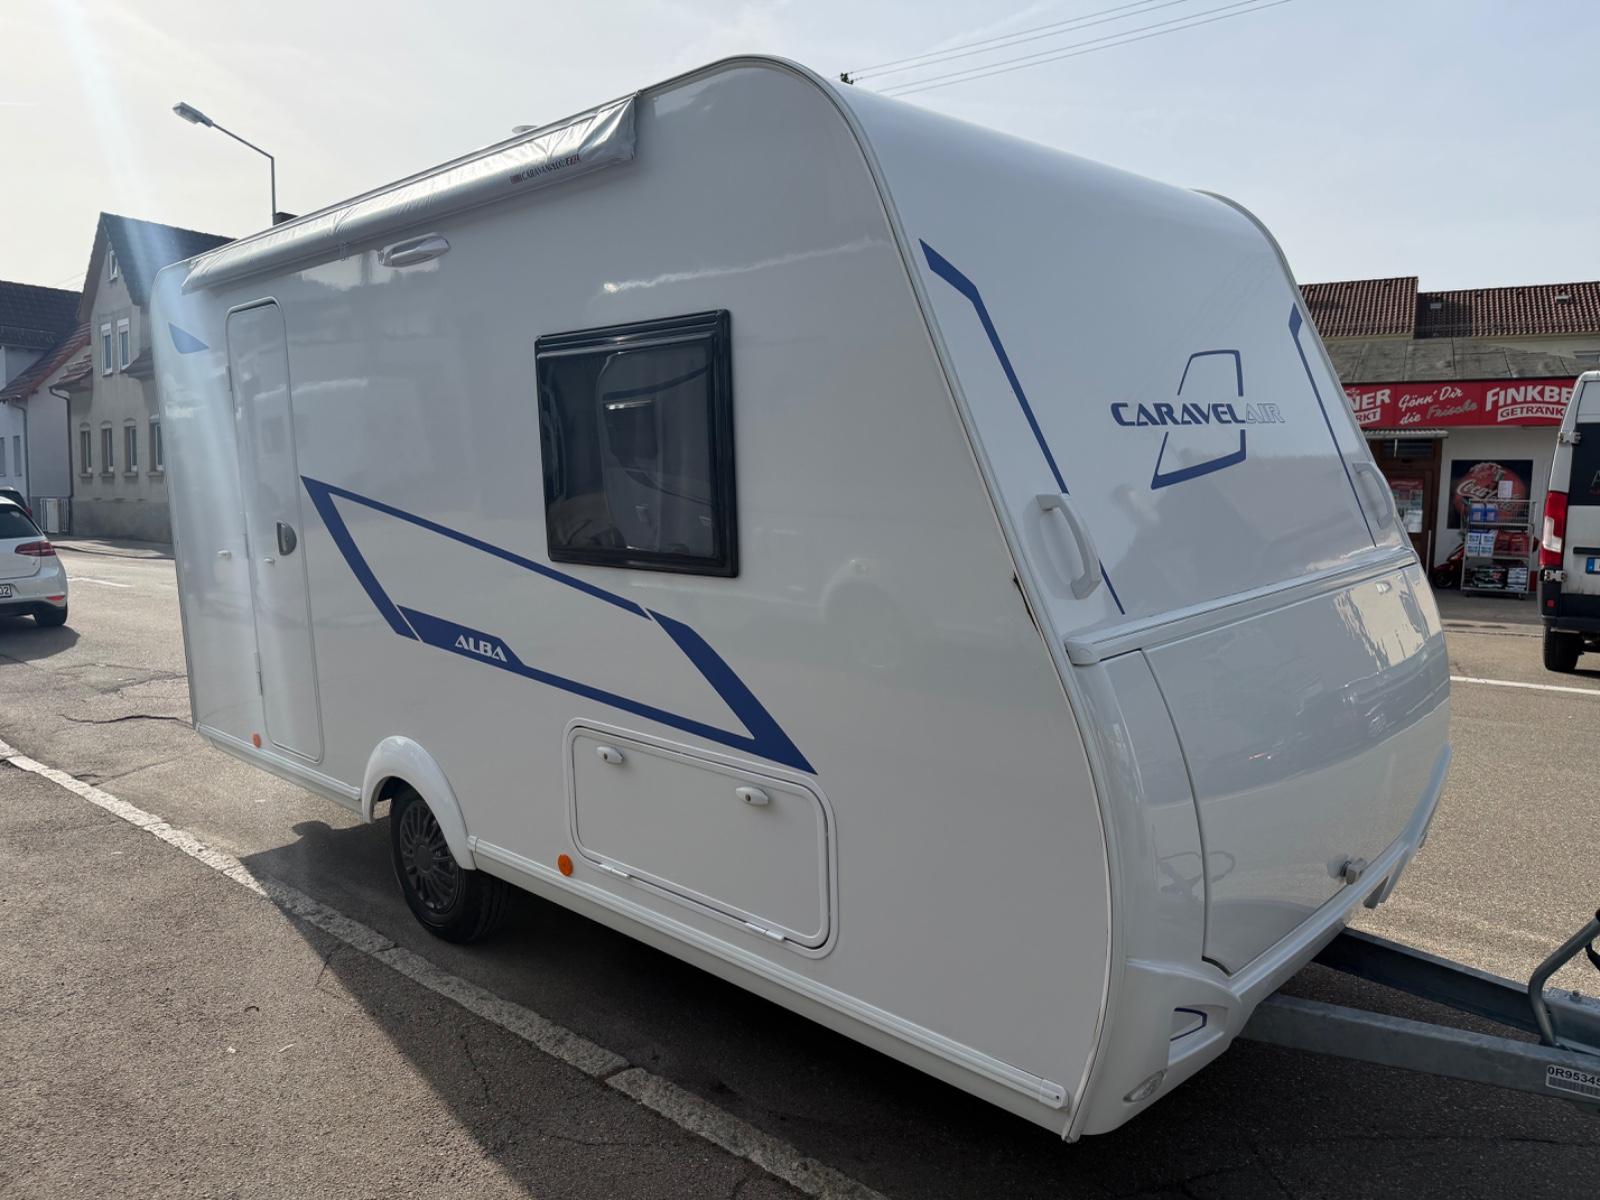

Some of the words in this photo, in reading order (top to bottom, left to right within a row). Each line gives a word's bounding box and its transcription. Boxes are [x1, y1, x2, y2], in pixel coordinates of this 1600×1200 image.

[1440, 386, 1462, 401] Dir
[1485, 385, 1574, 412] FINKBE
[1110, 402, 1286, 427] CARAVELAIR
[1400, 411, 1421, 425] die
[1500, 405, 1564, 418] GETRÄNK
[454, 634, 508, 663] ALBA
